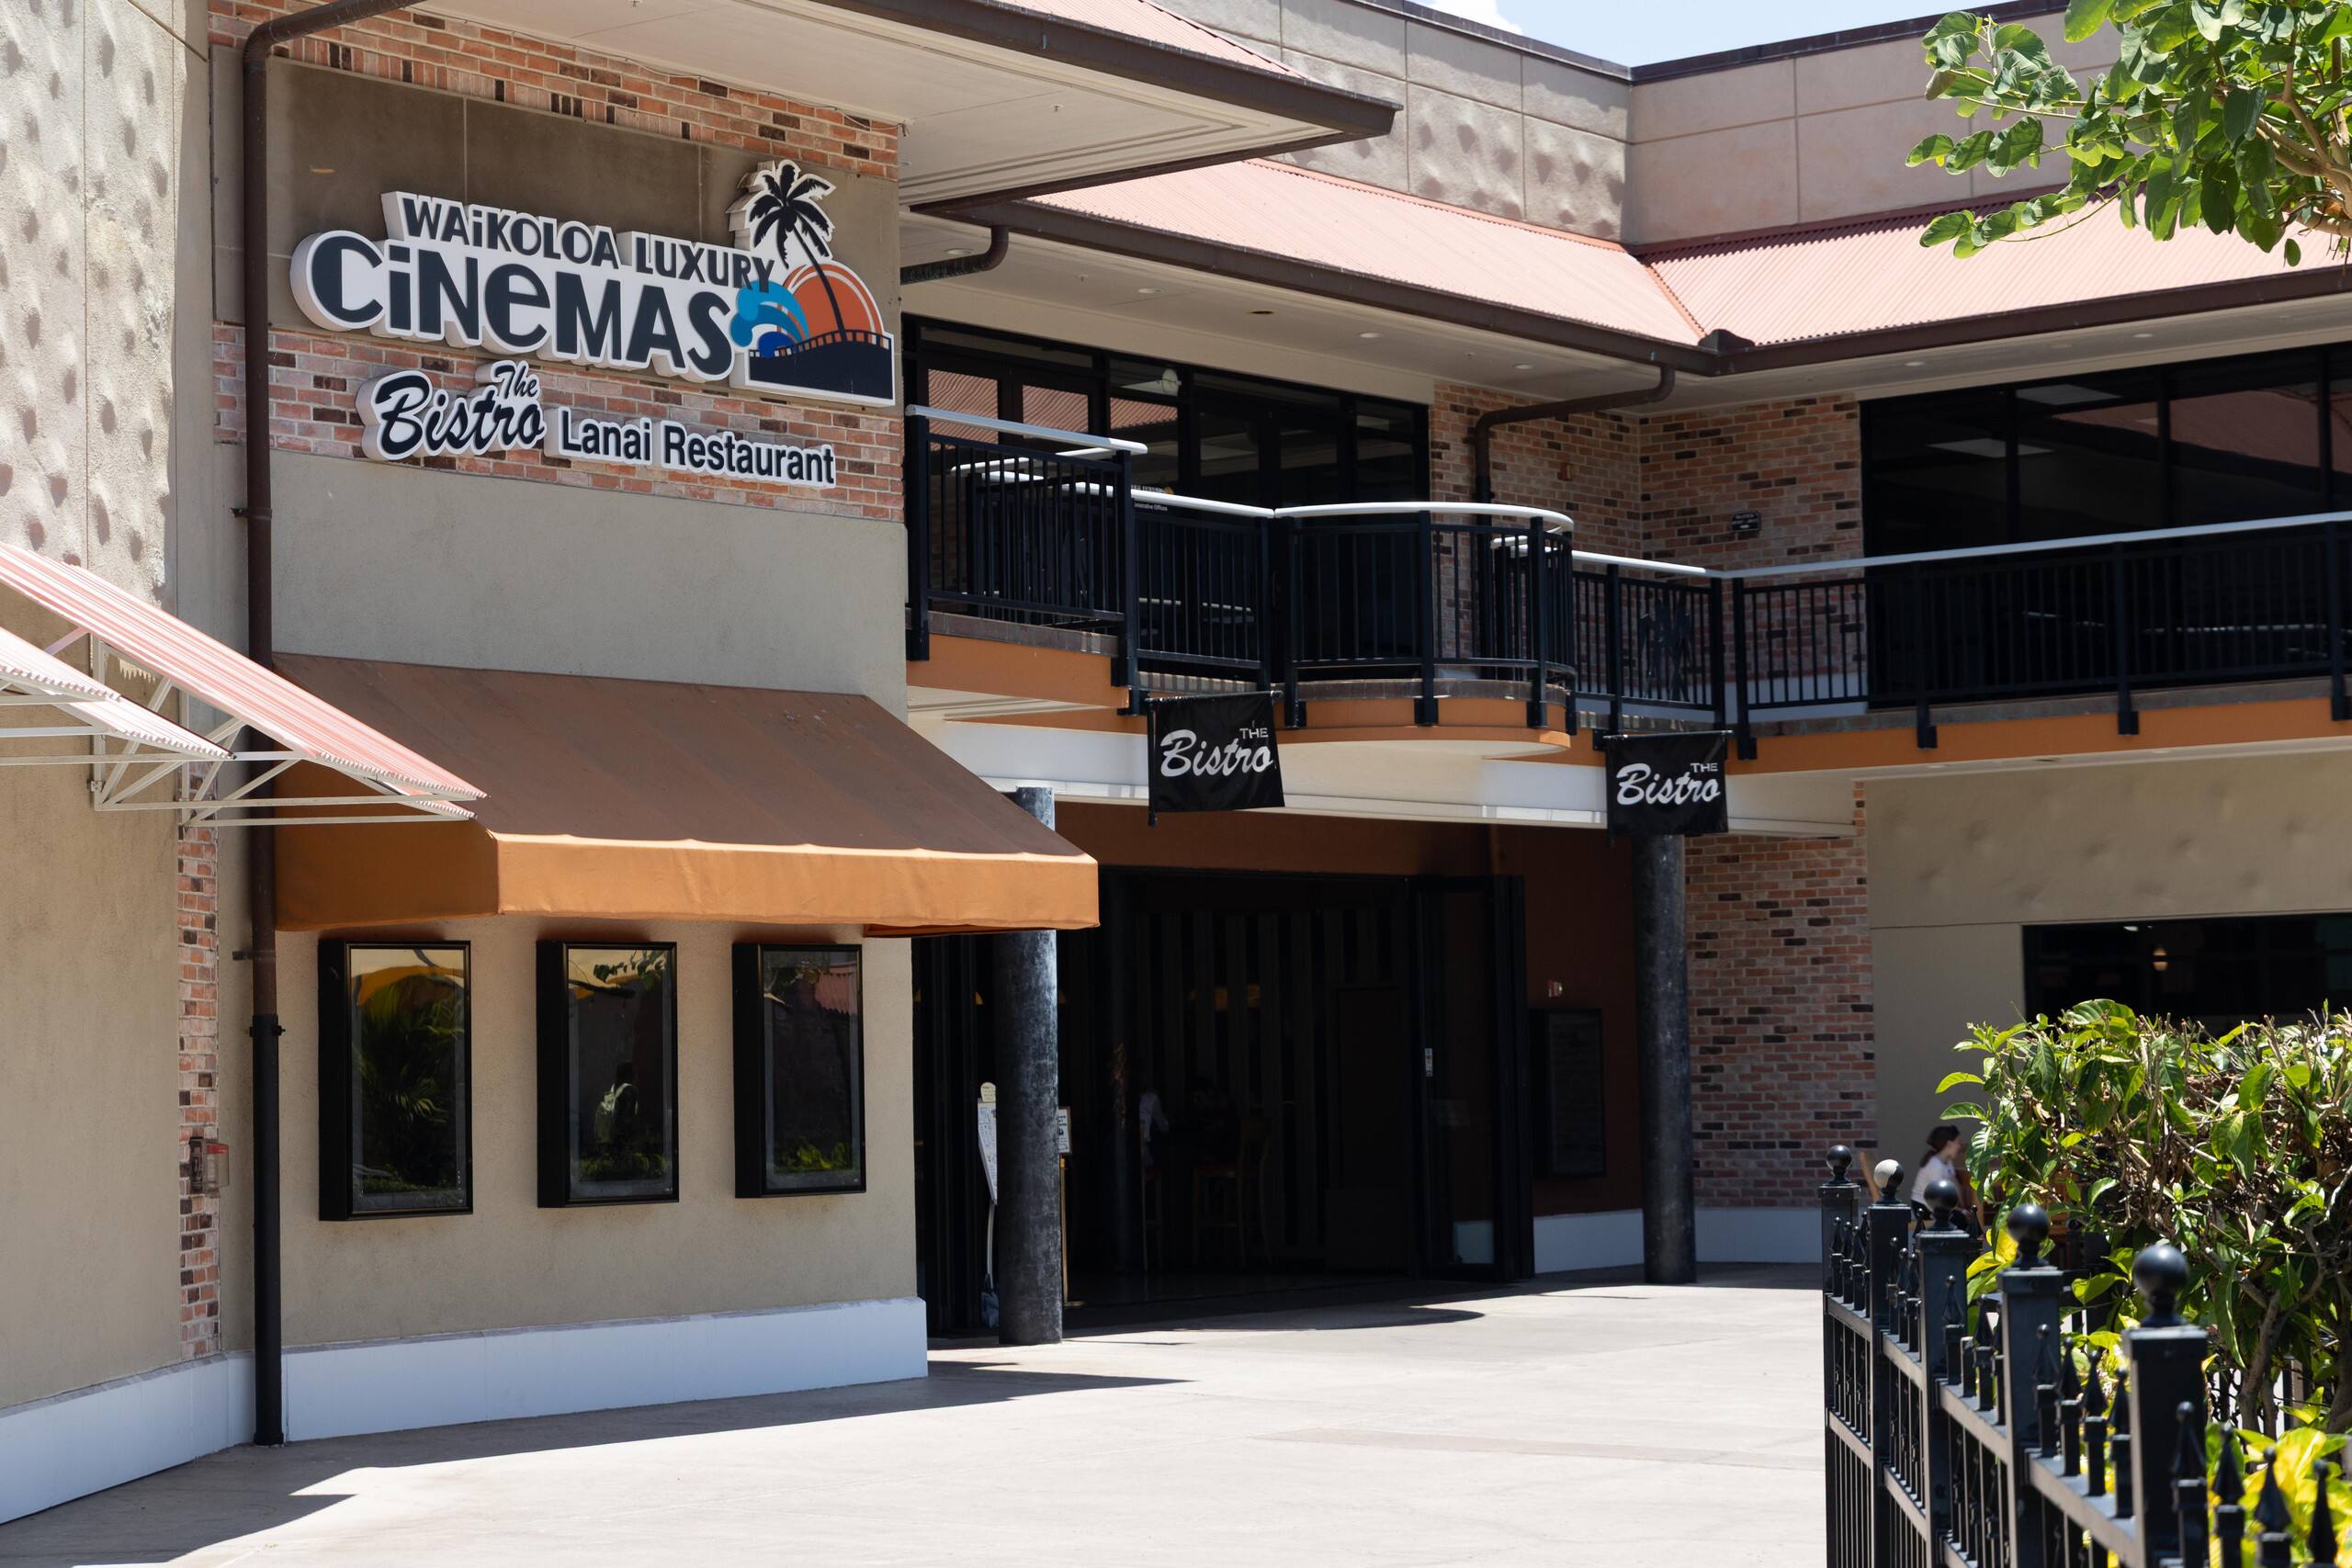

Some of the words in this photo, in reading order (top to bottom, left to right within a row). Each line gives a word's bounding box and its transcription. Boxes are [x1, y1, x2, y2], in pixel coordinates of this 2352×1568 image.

[402, 197, 619, 270] WAiKOLOA
[636, 237, 776, 295] LUXURY
[494, 364, 538, 400] The
[375, 374, 545, 456] Bistro
[562, 410, 651, 461] Lanai
[664, 424, 835, 484] Restaurant
[1159, 728, 1274, 777] Bistro
[1239, 727, 1269, 739] THE
[1616, 762, 1721, 806] Bistro
[1690, 762, 1719, 773] THE
